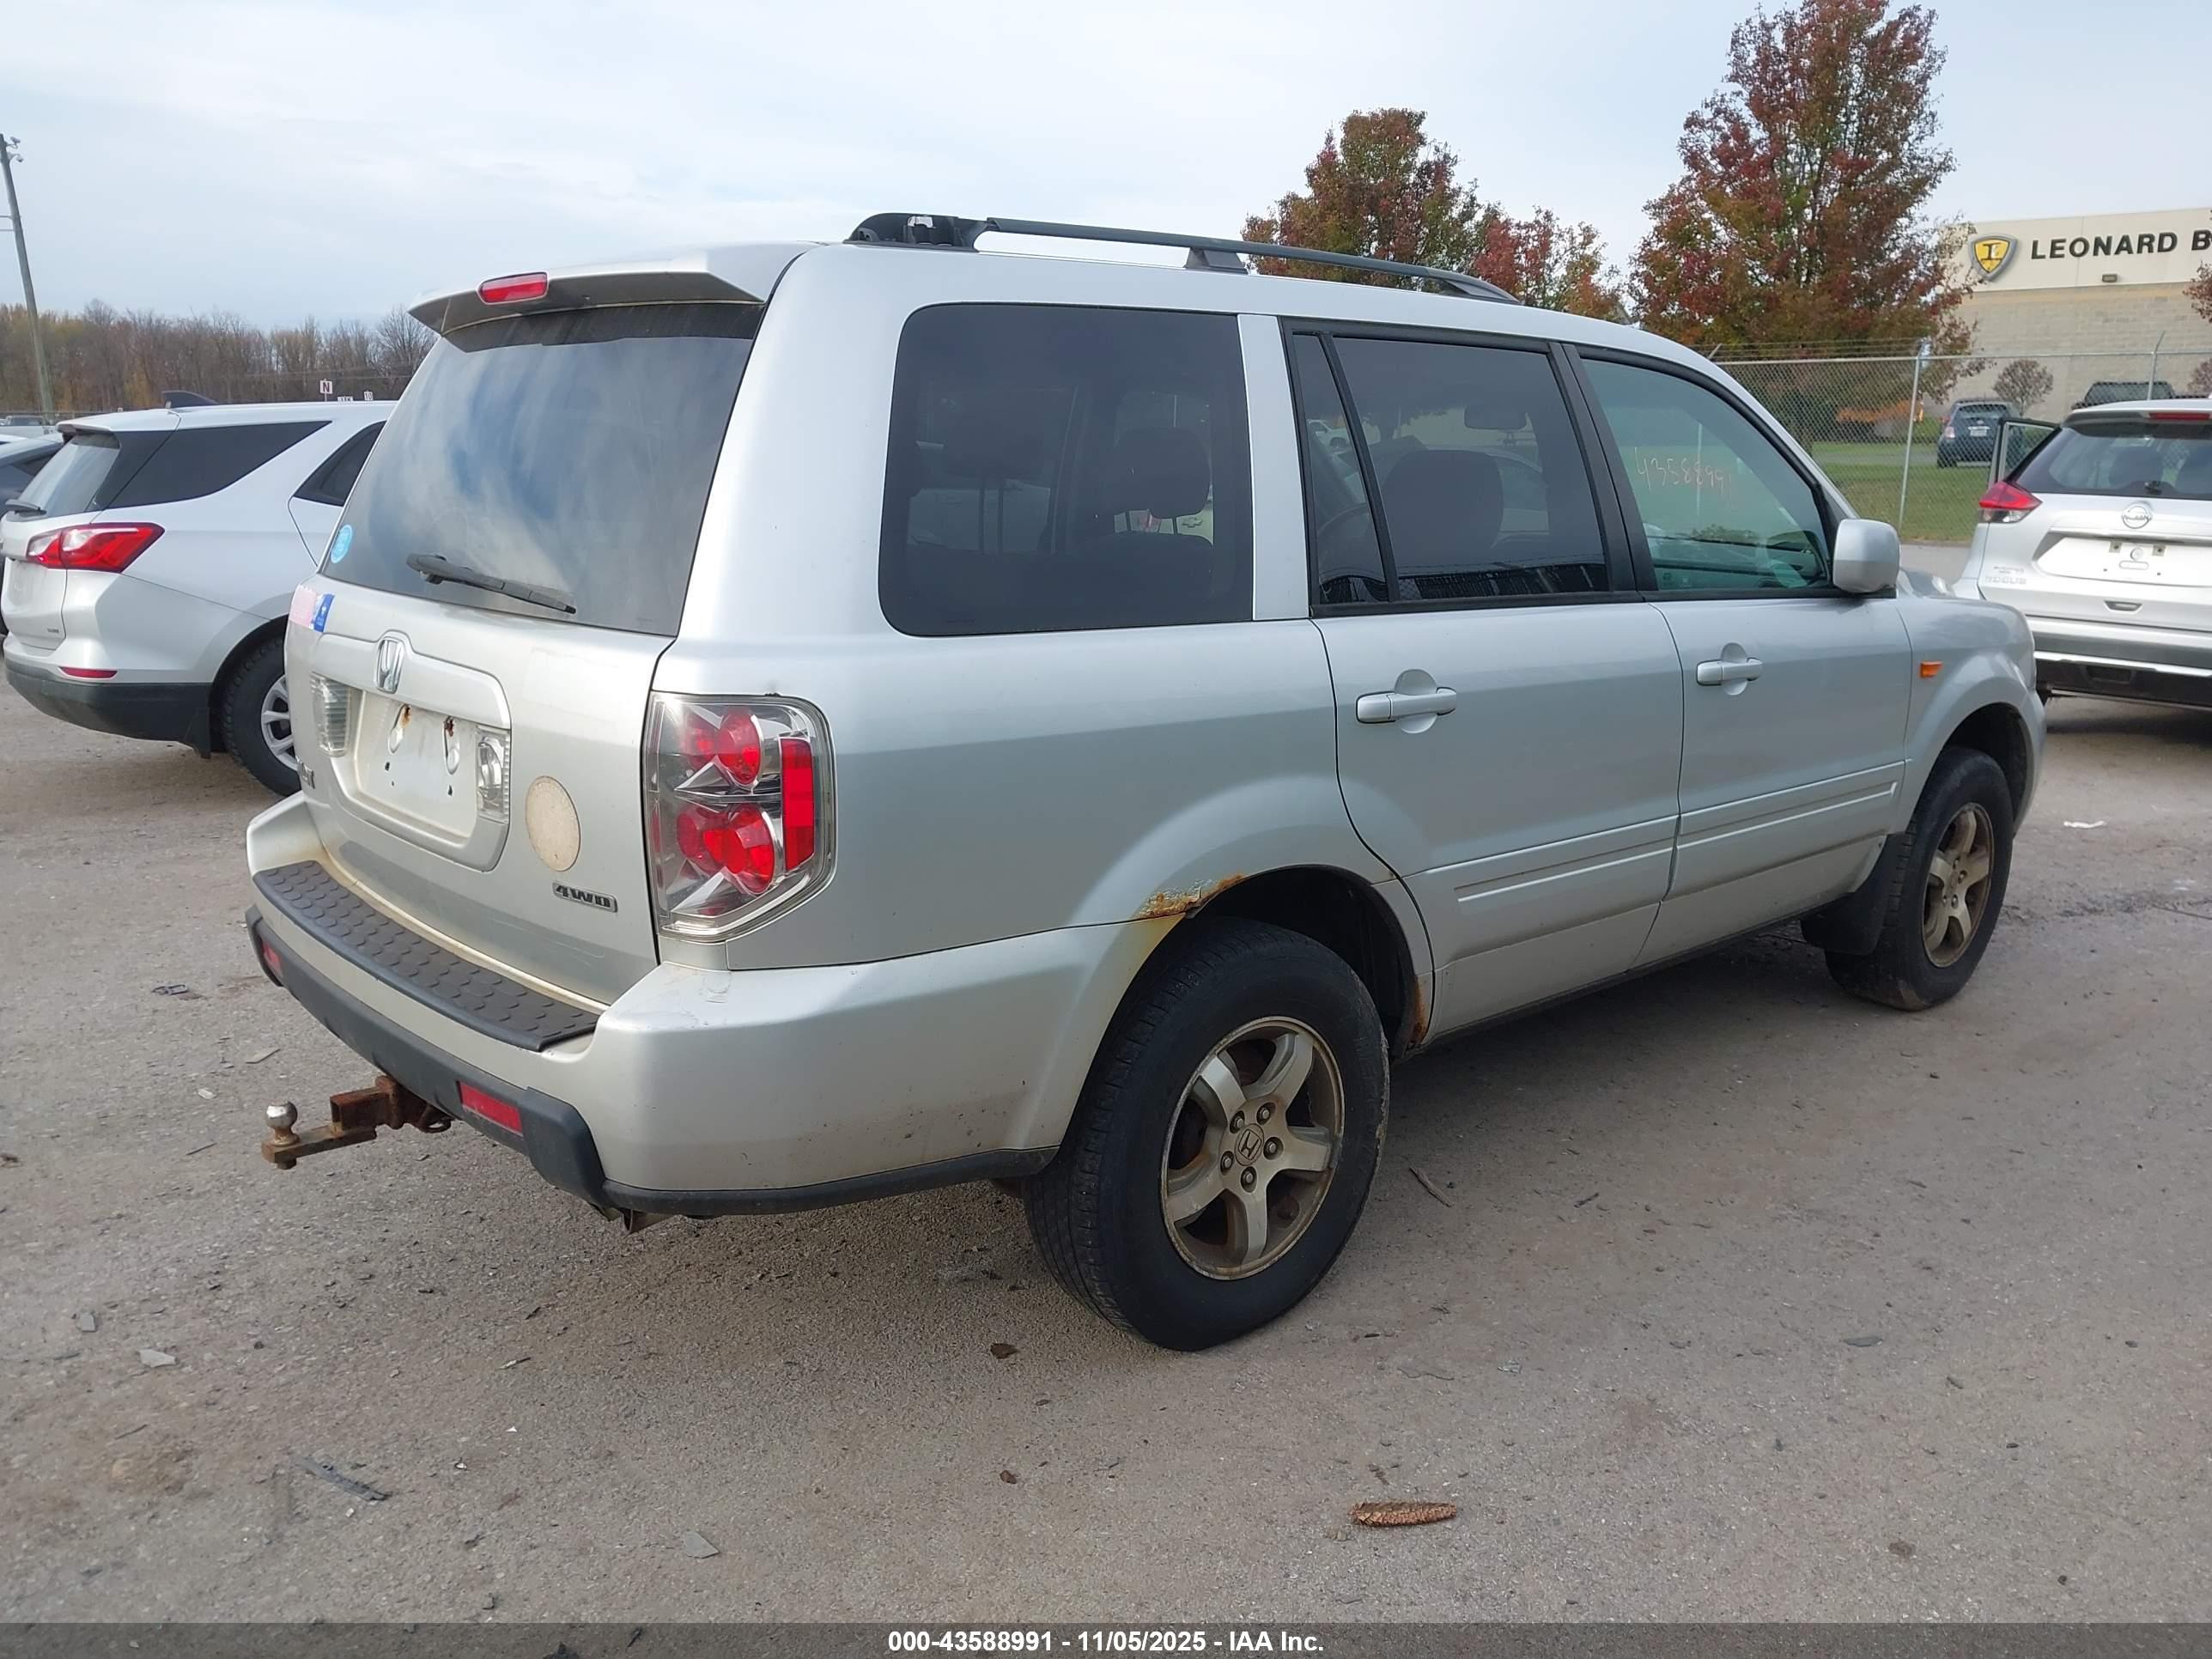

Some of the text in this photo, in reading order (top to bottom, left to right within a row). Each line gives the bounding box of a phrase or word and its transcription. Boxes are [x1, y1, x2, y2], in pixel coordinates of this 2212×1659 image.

[2031, 229, 2212, 260] LEONARD B
[322, 381, 331, 393] N
[556, 885, 611, 908] 4WD
